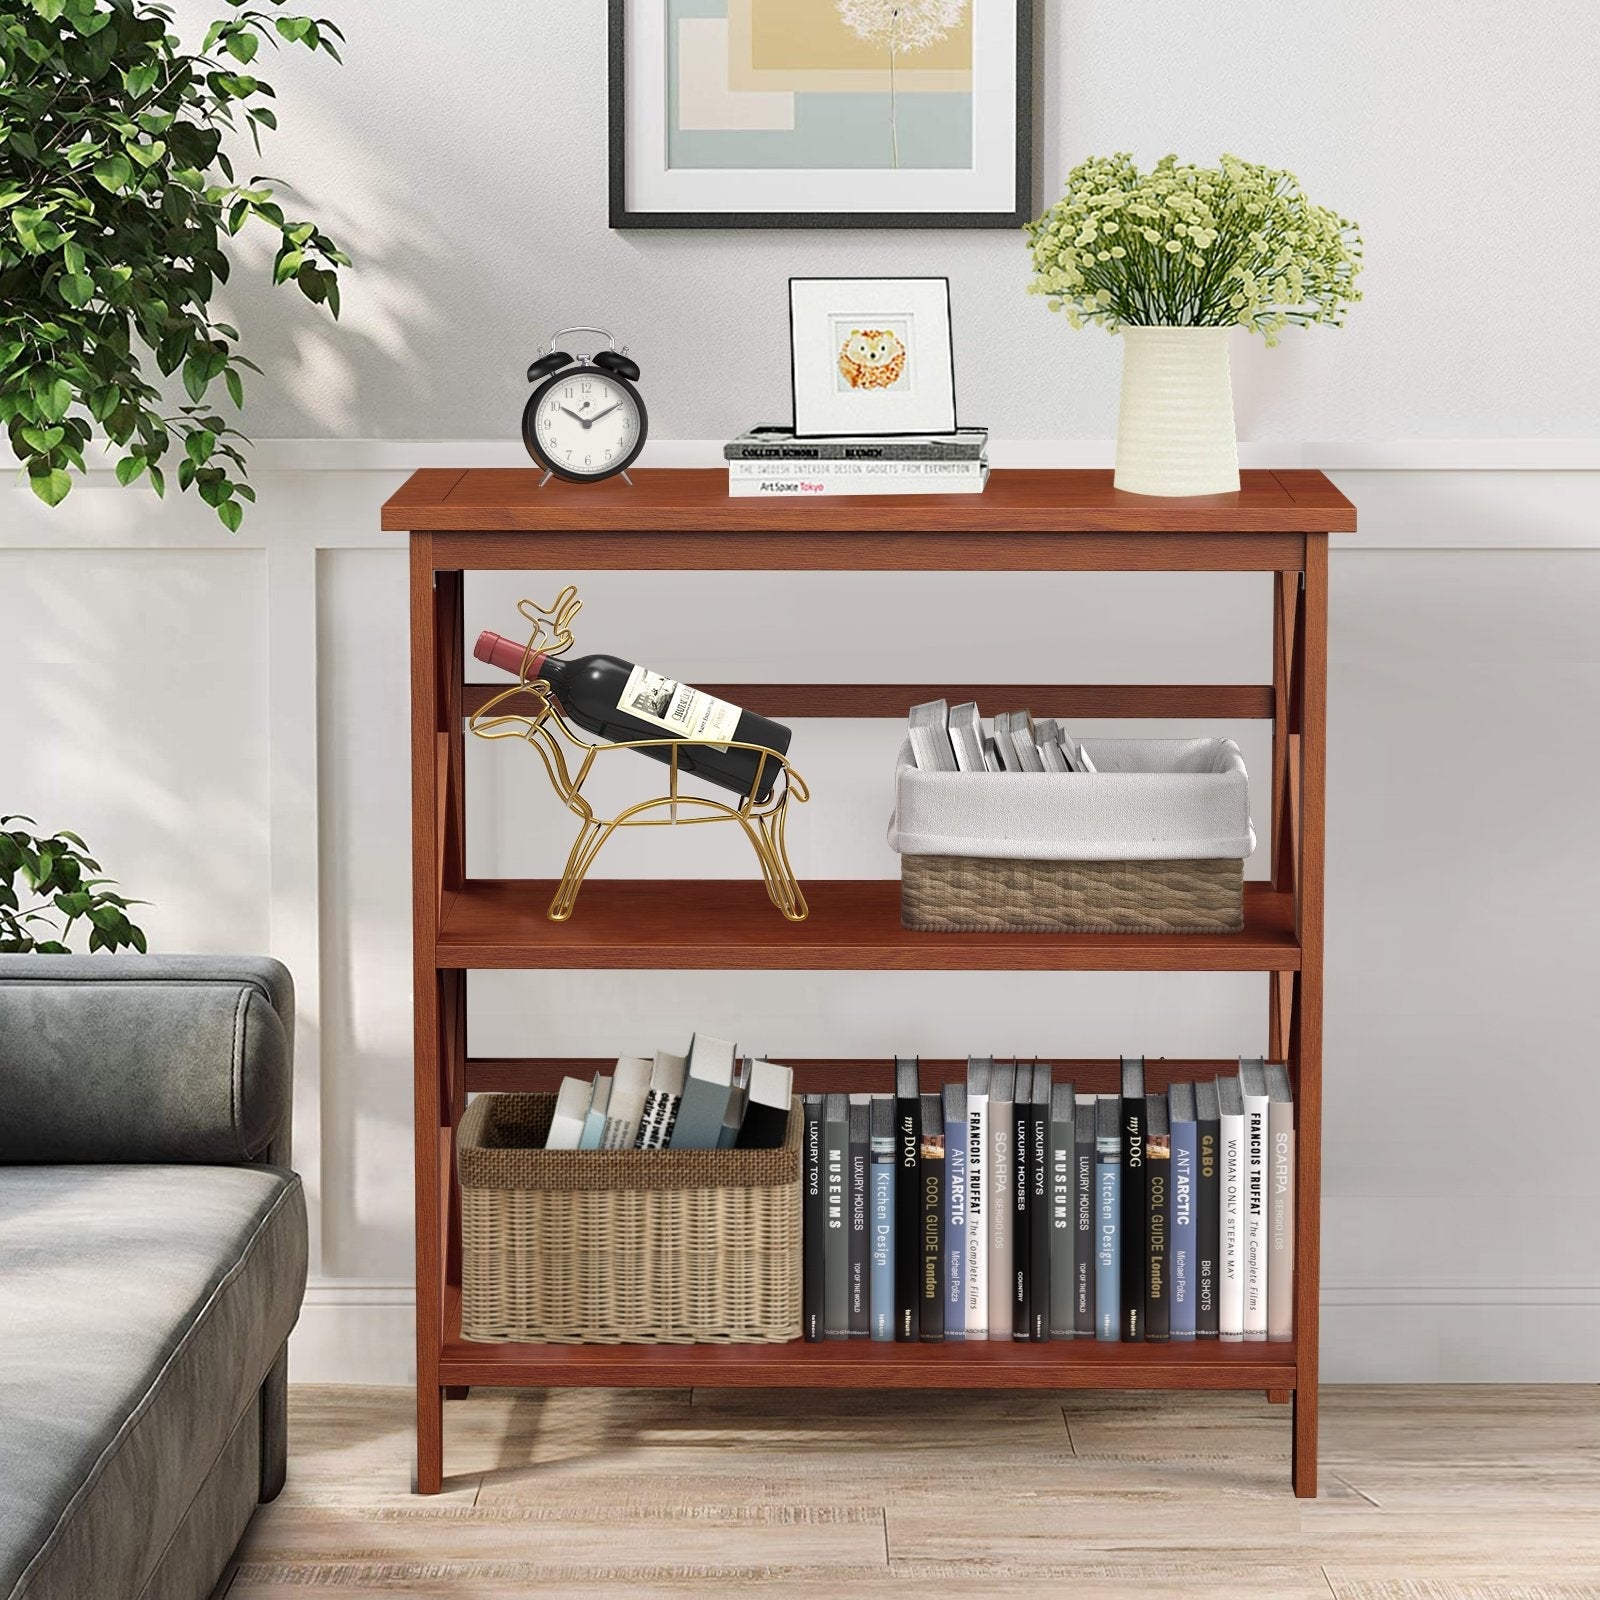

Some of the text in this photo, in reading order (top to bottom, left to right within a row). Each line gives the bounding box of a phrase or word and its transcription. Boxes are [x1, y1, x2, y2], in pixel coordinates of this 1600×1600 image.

[551, 401, 561, 412] 10
[565, 387, 573, 399] 11
[581, 382, 592, 394] 12
[603, 387, 608, 398] 1
[616, 401, 624, 411] 2
[543, 419, 551, 431] 9
[550, 437, 557, 448] 8
[617, 436, 624, 448] 4
[622, 418, 630, 429] 3
[565, 449, 573, 461] 7
[584, 454, 592, 466] 6
[604, 449, 612, 460] 5
[740, 464, 752, 474] THE
[757, 464, 789, 474] SWEDISH
[794, 464, 830, 474] INTERIOR
[834, 464, 862, 474] DESIGN
[800, 481, 824, 493] Tokyo
[810, 1121, 818, 1195] LUXURY TOYS
[901, 1117, 915, 1167] my DOG
[970, 1112, 980, 1214] FRANCOIS TRUFFAT
[1126, 1117, 1141, 1167] my DOG
[1202, 1136, 1213, 1177] GABO
[1251, 1113, 1261, 1215] FRANCOIS TRUFFAT
[830, 1150, 841, 1229] MUSEUMS
[854, 1156, 863, 1230] LUXURY HOUSES
[952, 1149, 963, 1225] ANTARCTIC
[995, 1132, 1007, 1248] SCARPA SERGIO LOS
[1055, 1150, 1066, 1229] MUSEUMS
[1080, 1156, 1089, 1230] LUXURY HOUSES
[1177, 1149, 1189, 1225] ANTARCTIC
[1227, 1140, 1236, 1279] WOMAN ONLY STEFAN MAY
[1275, 1133, 1287, 1250] SCARPA SERGIO LOS
[874, 1173, 889, 1265] Kitchen Design
[926, 1177, 937, 1298] COOL GUIDE London
[1100, 1173, 1114, 1265] Kitchen Design
[1151, 1177, 1162, 1298] COOL GUIDE London
[951, 1251, 960, 1302] Michael Poliza
[969, 1220, 978, 1310] The Complete Films
[1177, 1251, 1186, 1302] Michael Poliza
[1201, 1260, 1210, 1310] BIG SHOTS
[1248, 1221, 1258, 1311] The Complete Films
